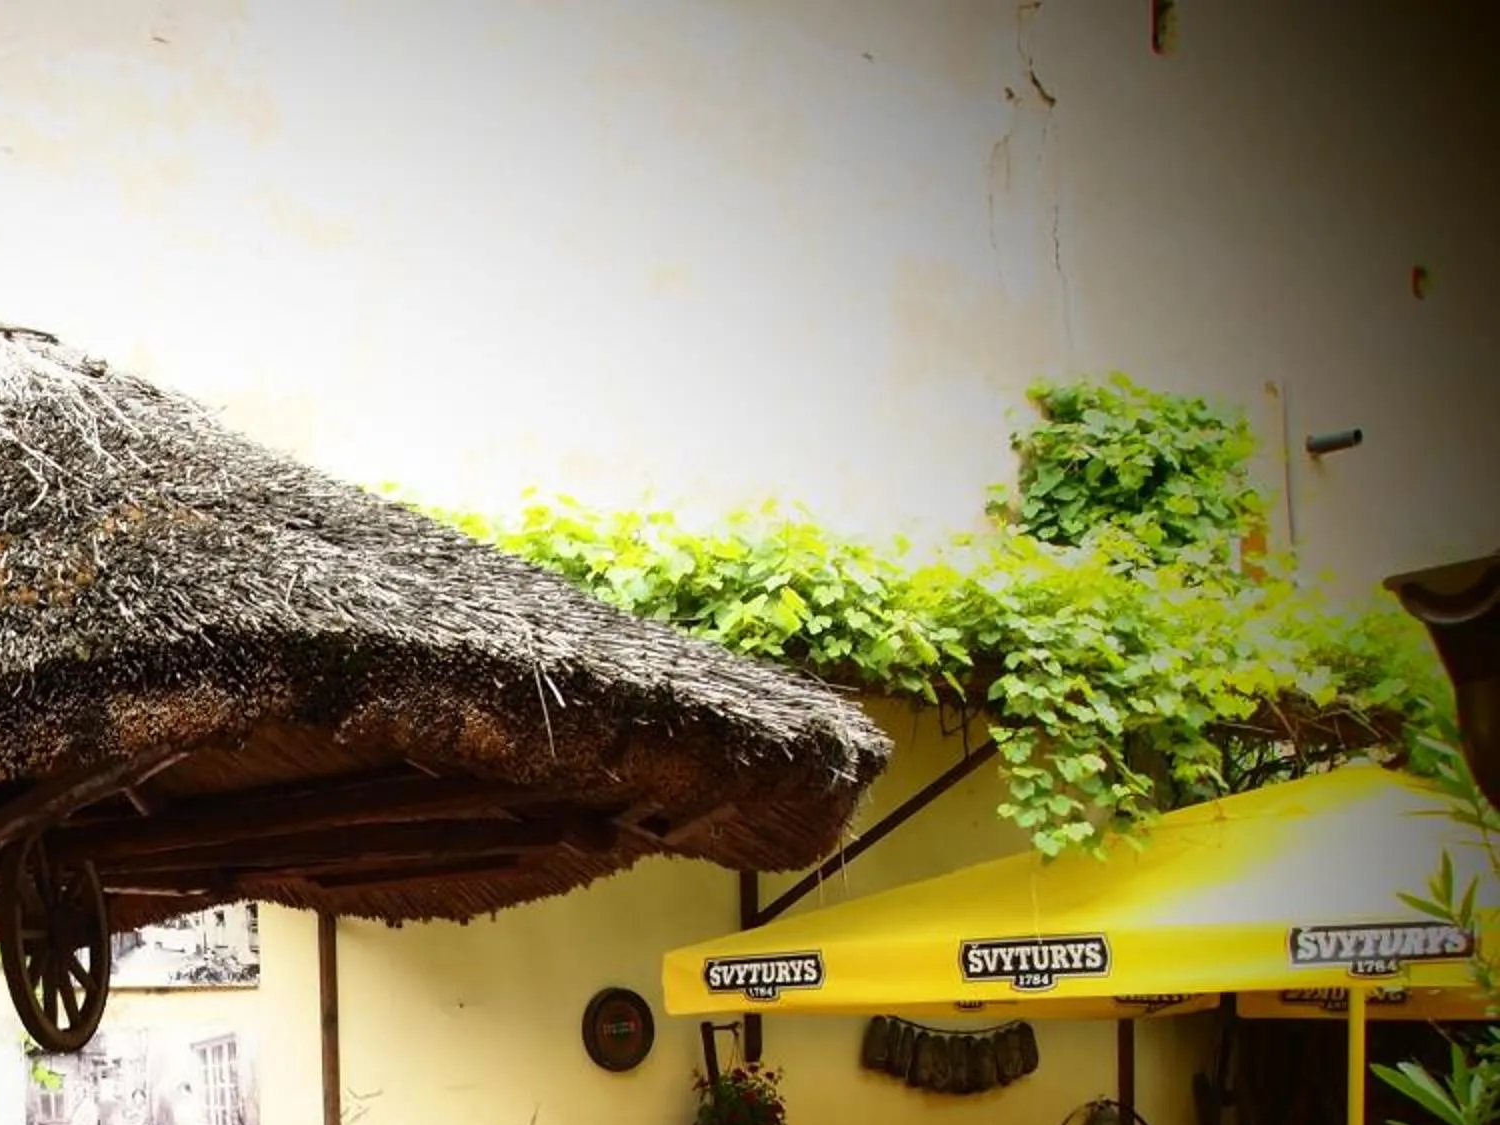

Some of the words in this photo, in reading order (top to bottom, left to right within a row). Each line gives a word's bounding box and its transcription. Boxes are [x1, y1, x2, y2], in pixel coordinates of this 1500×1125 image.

[967, 943, 1103, 973] ŠVYTURYS
[1356, 960, 1398, 973] 1784
[1018, 973, 1050, 986] 1784
